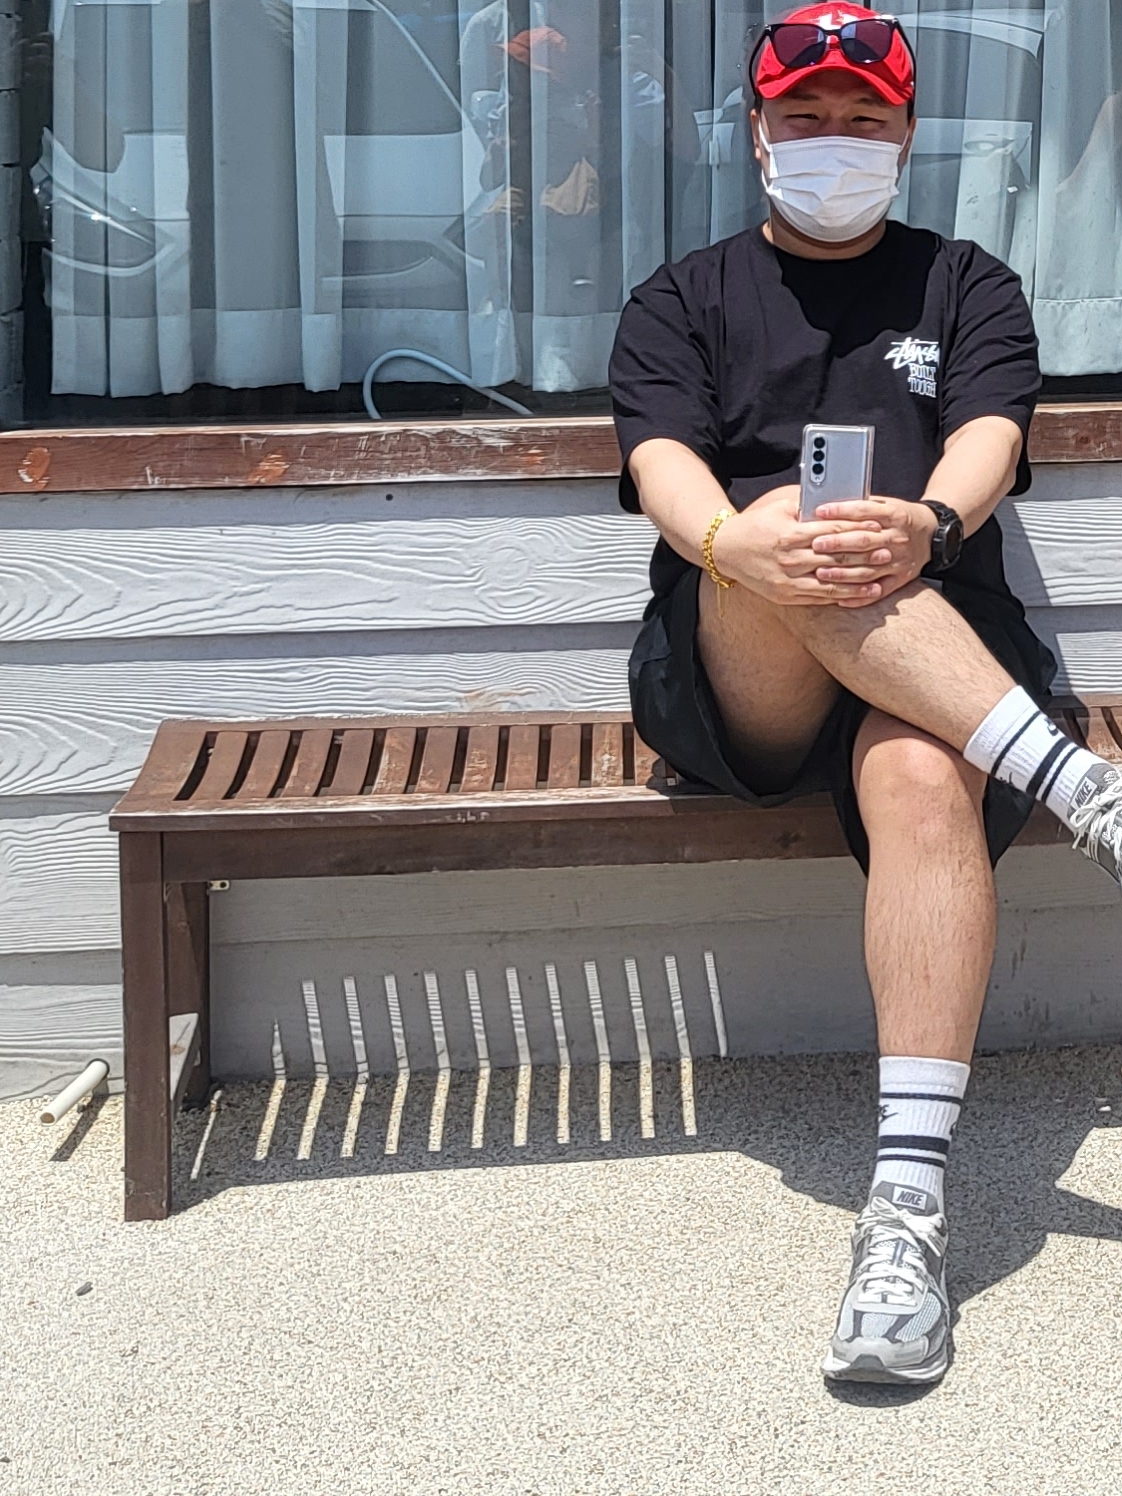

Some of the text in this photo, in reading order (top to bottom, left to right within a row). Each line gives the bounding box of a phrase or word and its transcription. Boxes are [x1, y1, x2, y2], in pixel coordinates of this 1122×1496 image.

[907, 362, 937, 382] BUILT
[907, 376, 937, 398] TOUGH
[1075, 780, 1093, 808] NIKE
[896, 1190, 924, 1206] NIKE
